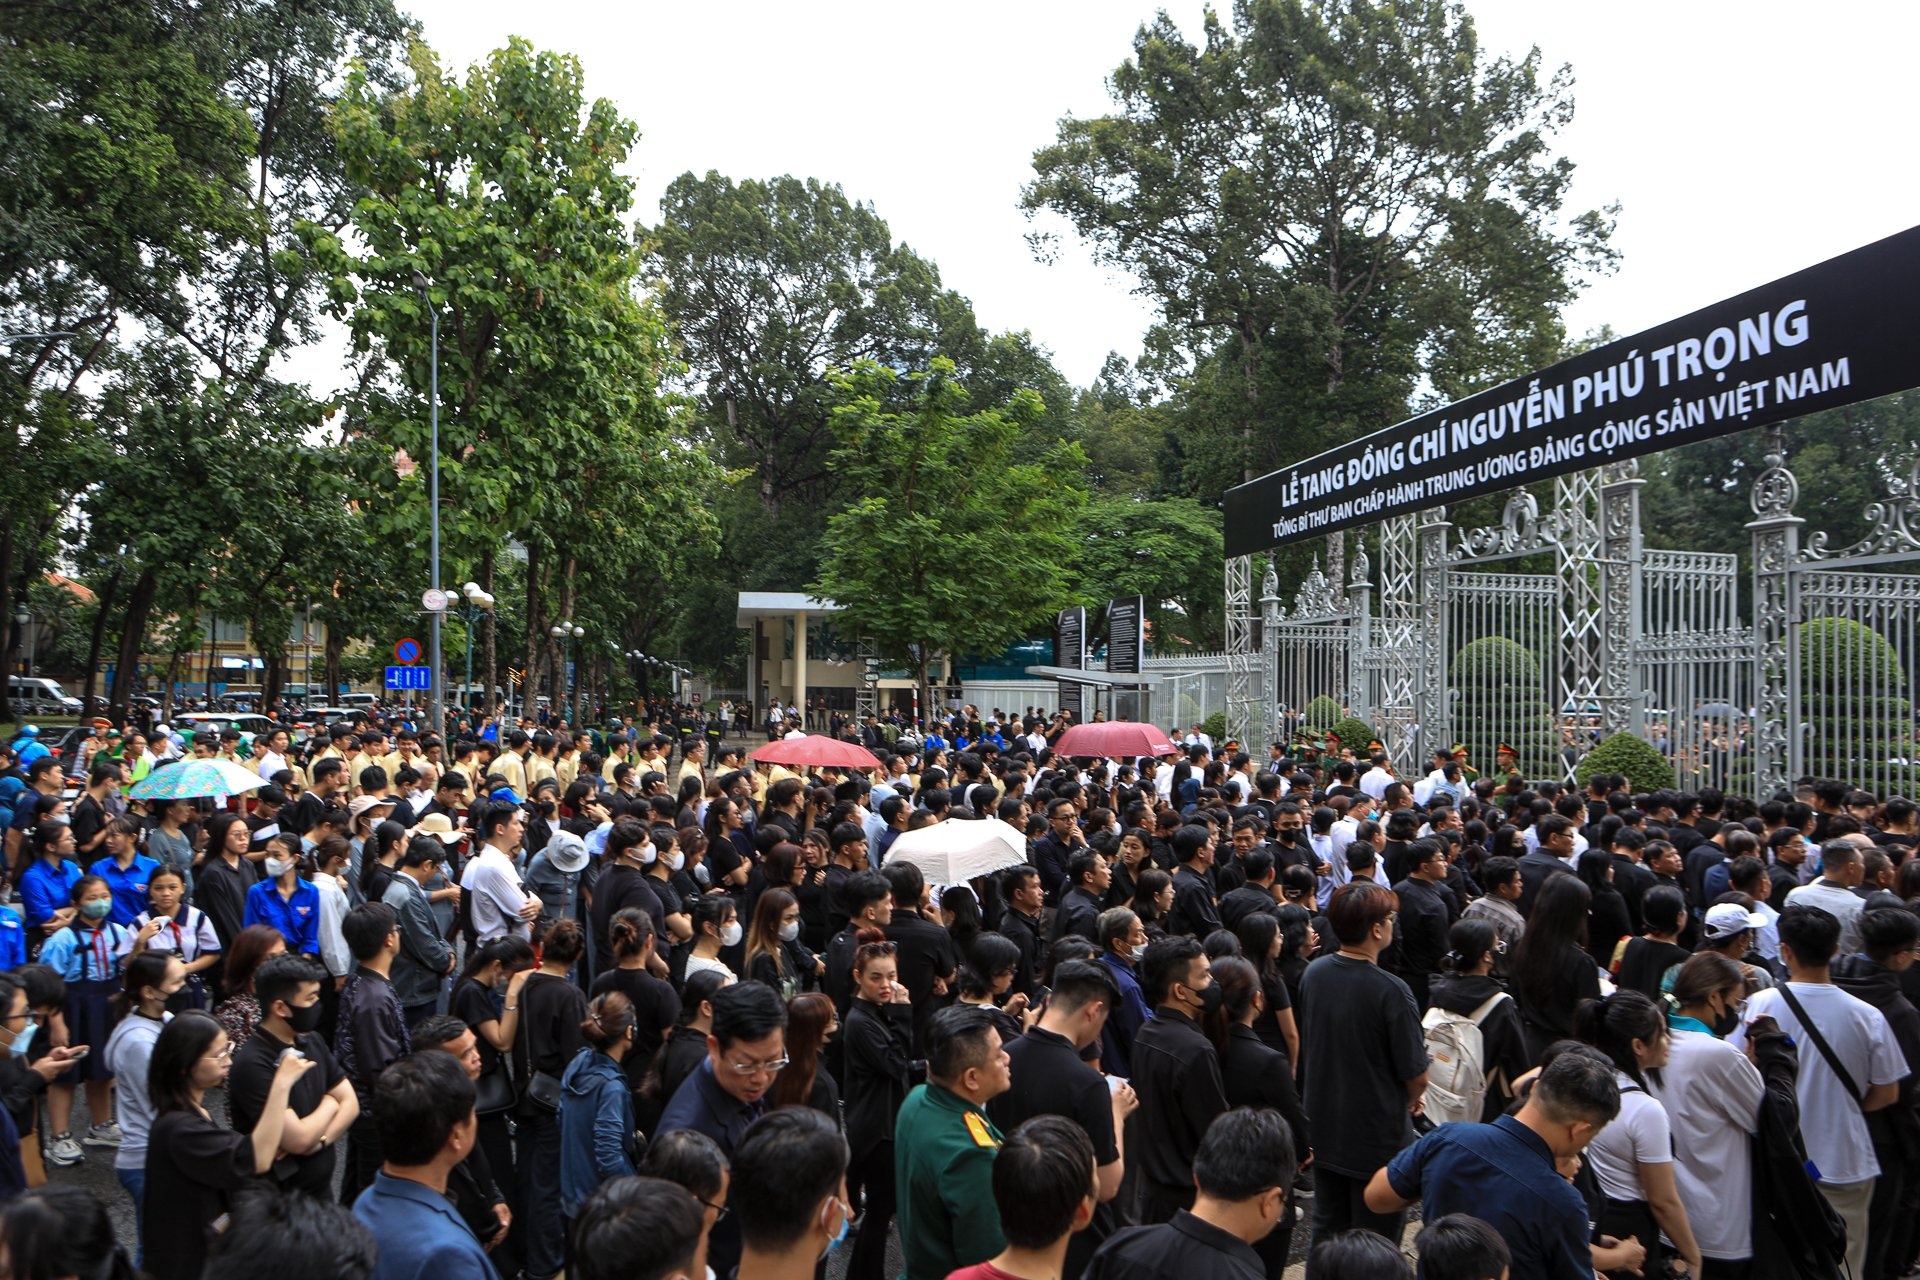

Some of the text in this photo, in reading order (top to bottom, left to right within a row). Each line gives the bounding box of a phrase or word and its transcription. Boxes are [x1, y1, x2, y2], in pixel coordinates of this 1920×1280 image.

[1272, 357, 1850, 538] TỔNG BÍ THƯ BAN CHẤP HÀNH TRUNG ƯƠNG ĐẢNG CỘNG SẢN VIỆT NAM
[1282, 299, 1809, 508] LỄ TANG ĐỒNG CHÍ NGUYỄN PHÚ TRỌNG
